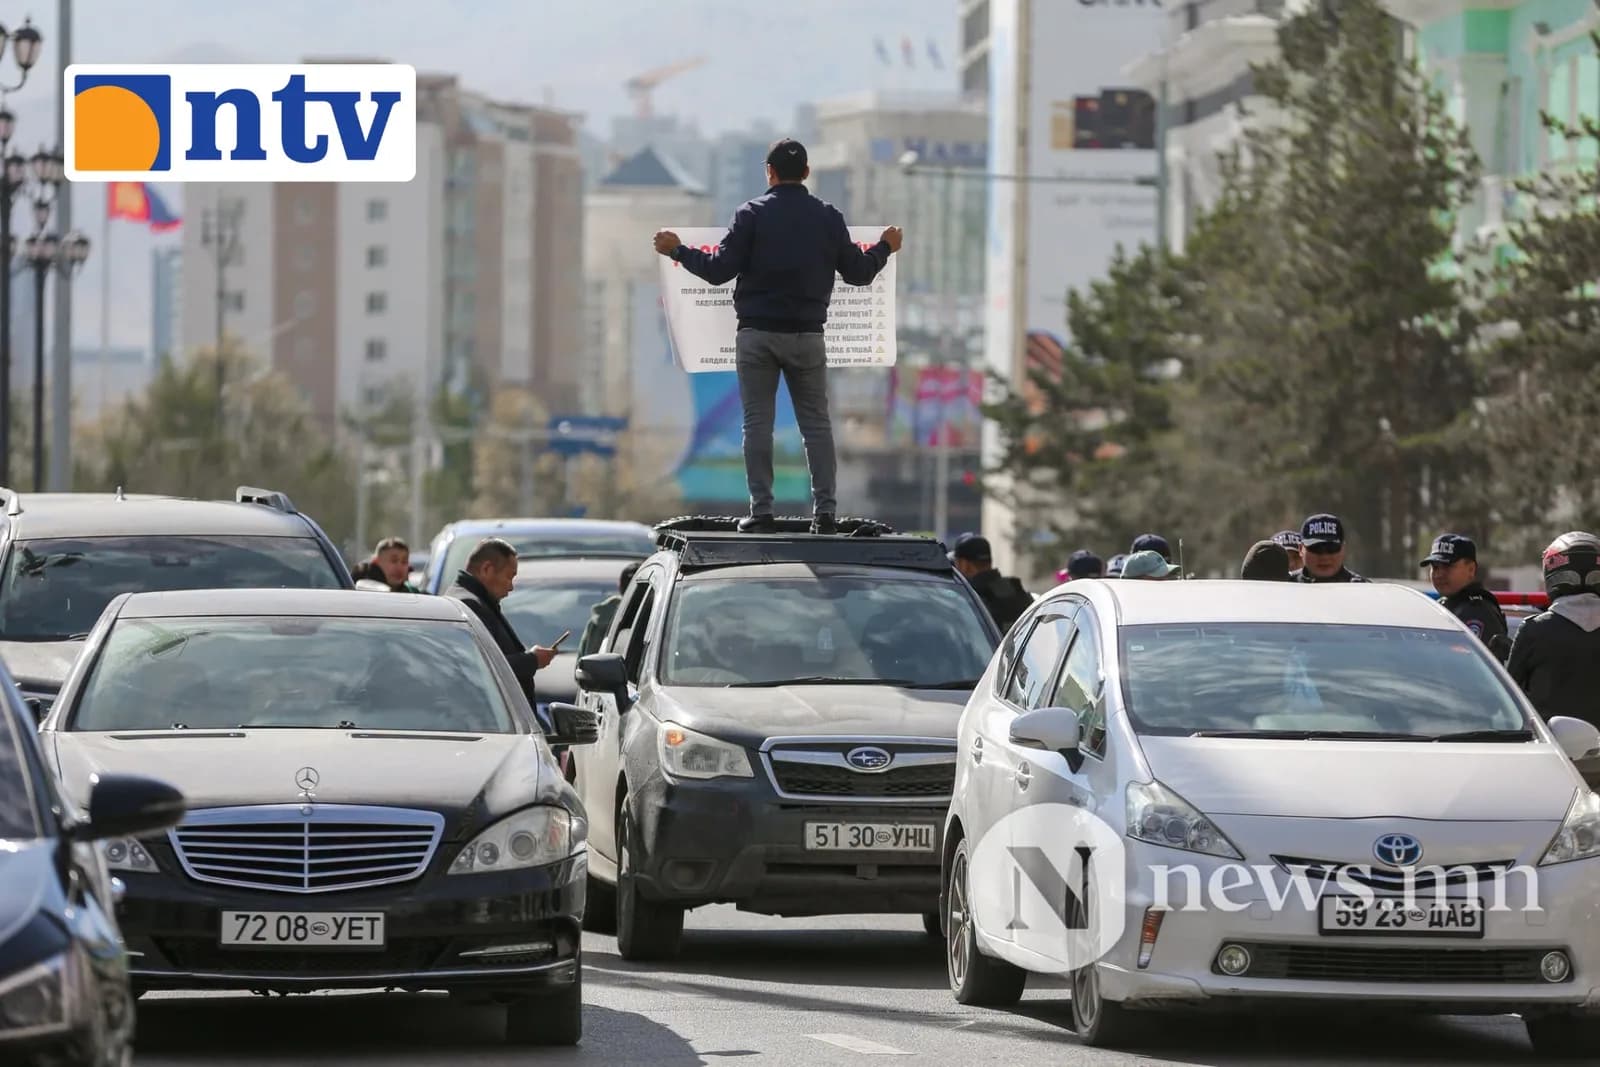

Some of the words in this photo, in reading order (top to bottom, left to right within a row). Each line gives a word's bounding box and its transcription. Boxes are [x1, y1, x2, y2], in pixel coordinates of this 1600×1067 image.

[1308, 521, 1337, 535] POLICE
[815, 825, 840, 847] 51
[848, 825, 875, 848] 30
[892, 827, 931, 848] УНЦ
[1335, 899, 1368, 927] 59
[1375, 900, 1407, 927] 23
[234, 914, 267, 941] 72
[275, 915, 309, 941] 08
[331, 916, 381, 941] УЕТ
